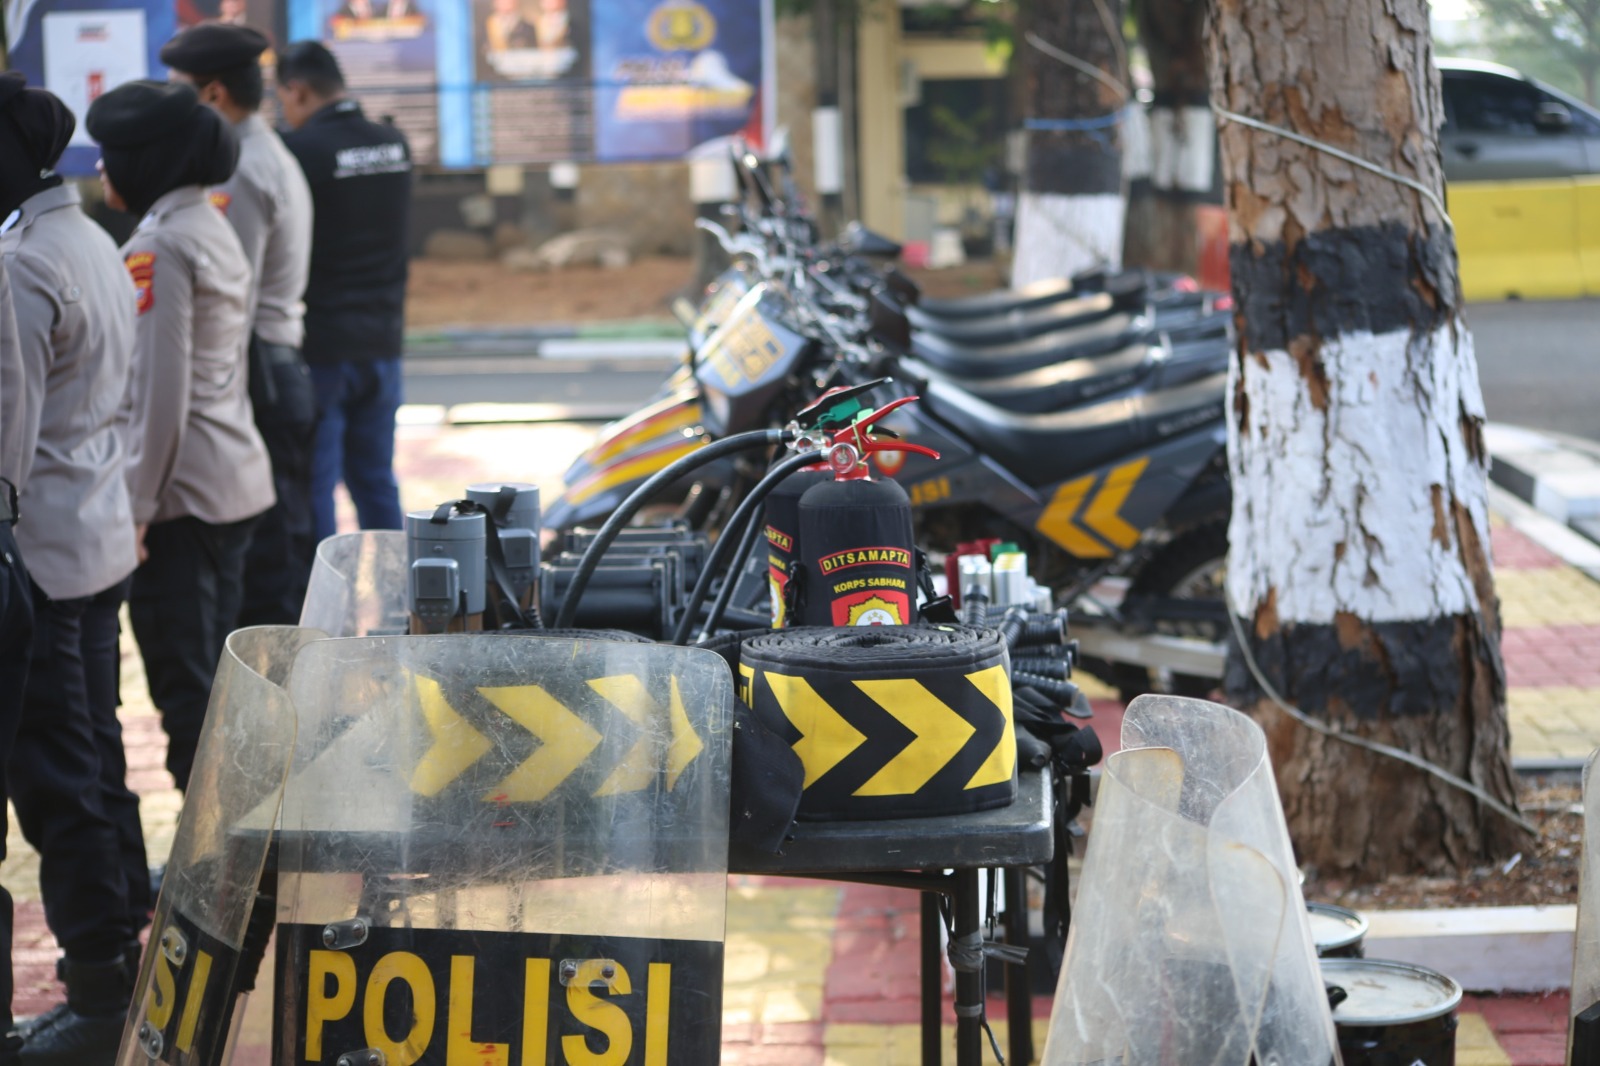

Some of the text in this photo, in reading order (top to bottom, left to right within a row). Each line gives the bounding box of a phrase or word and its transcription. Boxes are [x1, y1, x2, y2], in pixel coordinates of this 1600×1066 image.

[822, 550, 908, 571] DITSAMAPTA
[833, 577, 906, 594] KORPS SABHARA
[304, 948, 672, 1066] POLISI
